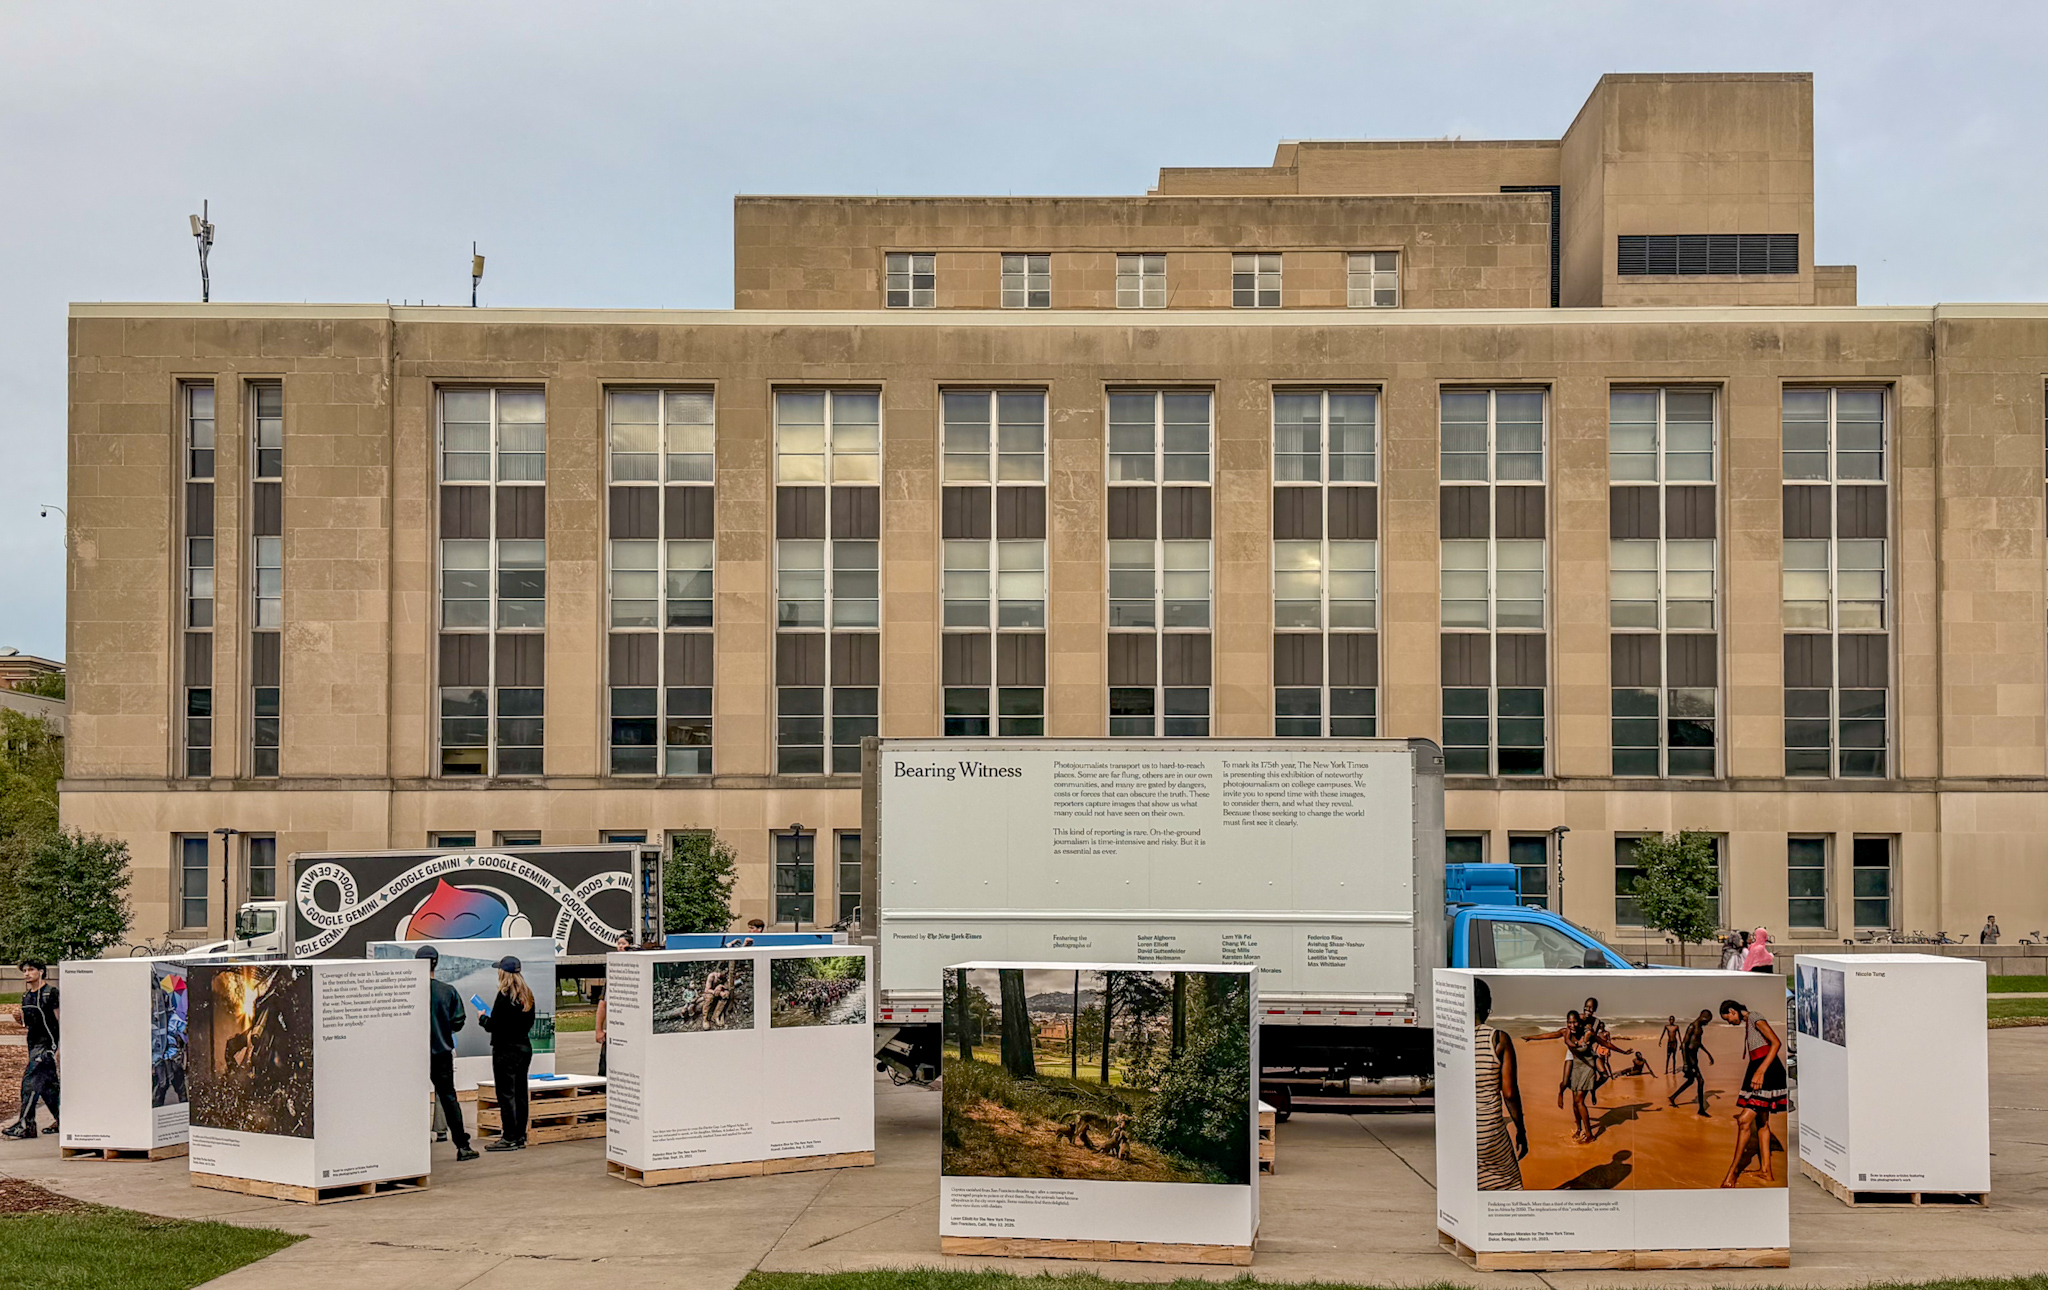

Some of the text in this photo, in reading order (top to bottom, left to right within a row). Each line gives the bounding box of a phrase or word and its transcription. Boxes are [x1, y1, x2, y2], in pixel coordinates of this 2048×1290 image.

[894, 761, 1022, 781] Bearing Witness
[1054, 761, 1108, 771] Photojournalists
[1110, 761, 1140, 771] transport
[1054, 770, 1076, 780] places.
[1121, 770, 1141, 780] flung,
[1230, 770, 1266, 780] presenting
[1324, 770, 1364, 780] noteworthy
[1054, 780, 1099, 789] communities,
[1148, 780, 1167, 790] gated
[1168, 780, 1176, 790] by
[1177, 780, 1206, 790] dangers,
[1223, 780, 1280, 790] photojournalism
[1291, 780, 1315, 790] college
[1265, 789, 1286, 799] spend
[1340, 790, 1366, 799] images,
[1054, 799, 1084, 809] reporters
[1085, 799, 1110, 809] capture
[1112, 799, 1136, 809] images
[1261, 799, 1281, 808] them,
[1315, 799, 1330, 809] they
[1272, 808, 1298, 818] seeking
[1307, 808, 1332, 818] change
[1275, 818, 1298, 828] clearly.
[1094, 828, 1125, 838] reporting
[1149, 828, 1201, 838] On-the-ground
[1053, 837, 1090, 847] journalism
[1161, 837, 1178, 847] risky.
[300, 866, 354, 905] GOOGLE GEMINI
[306, 856, 619, 943] GOOGLE GEMINI GOOGLE GEMINI GOOGLE GEMINI GOOGLE GEMIN
[556, 908, 572, 940] EMINI
[919, 932, 926, 941] by
[951, 932, 964, 941] York
